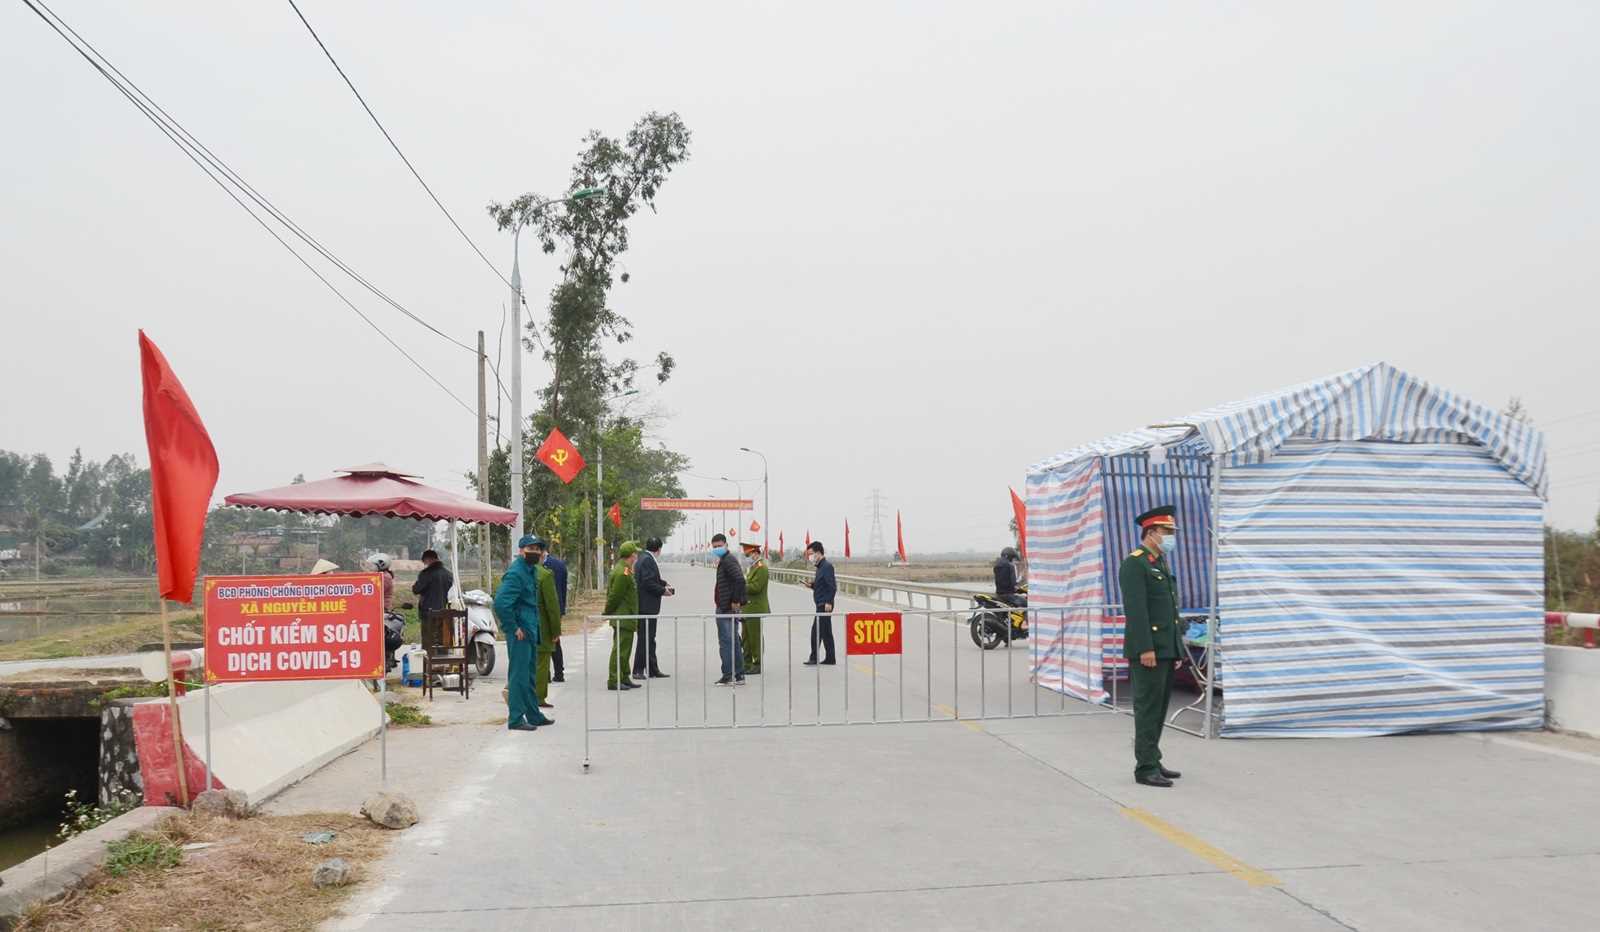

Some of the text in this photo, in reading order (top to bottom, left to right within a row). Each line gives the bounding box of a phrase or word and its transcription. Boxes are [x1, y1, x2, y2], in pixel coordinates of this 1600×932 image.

[238, 584, 269, 599] PHÒNG
[303, 585, 325, 599] DỊCH
[327, 585, 353, 596] COVID
[362, 584, 373, 595] 19
[218, 618, 370, 646] CHỐT KIỂM SOÁT
[854, 620, 895, 644] STOP
[227, 650, 361, 675] DỊCH COVID-19
